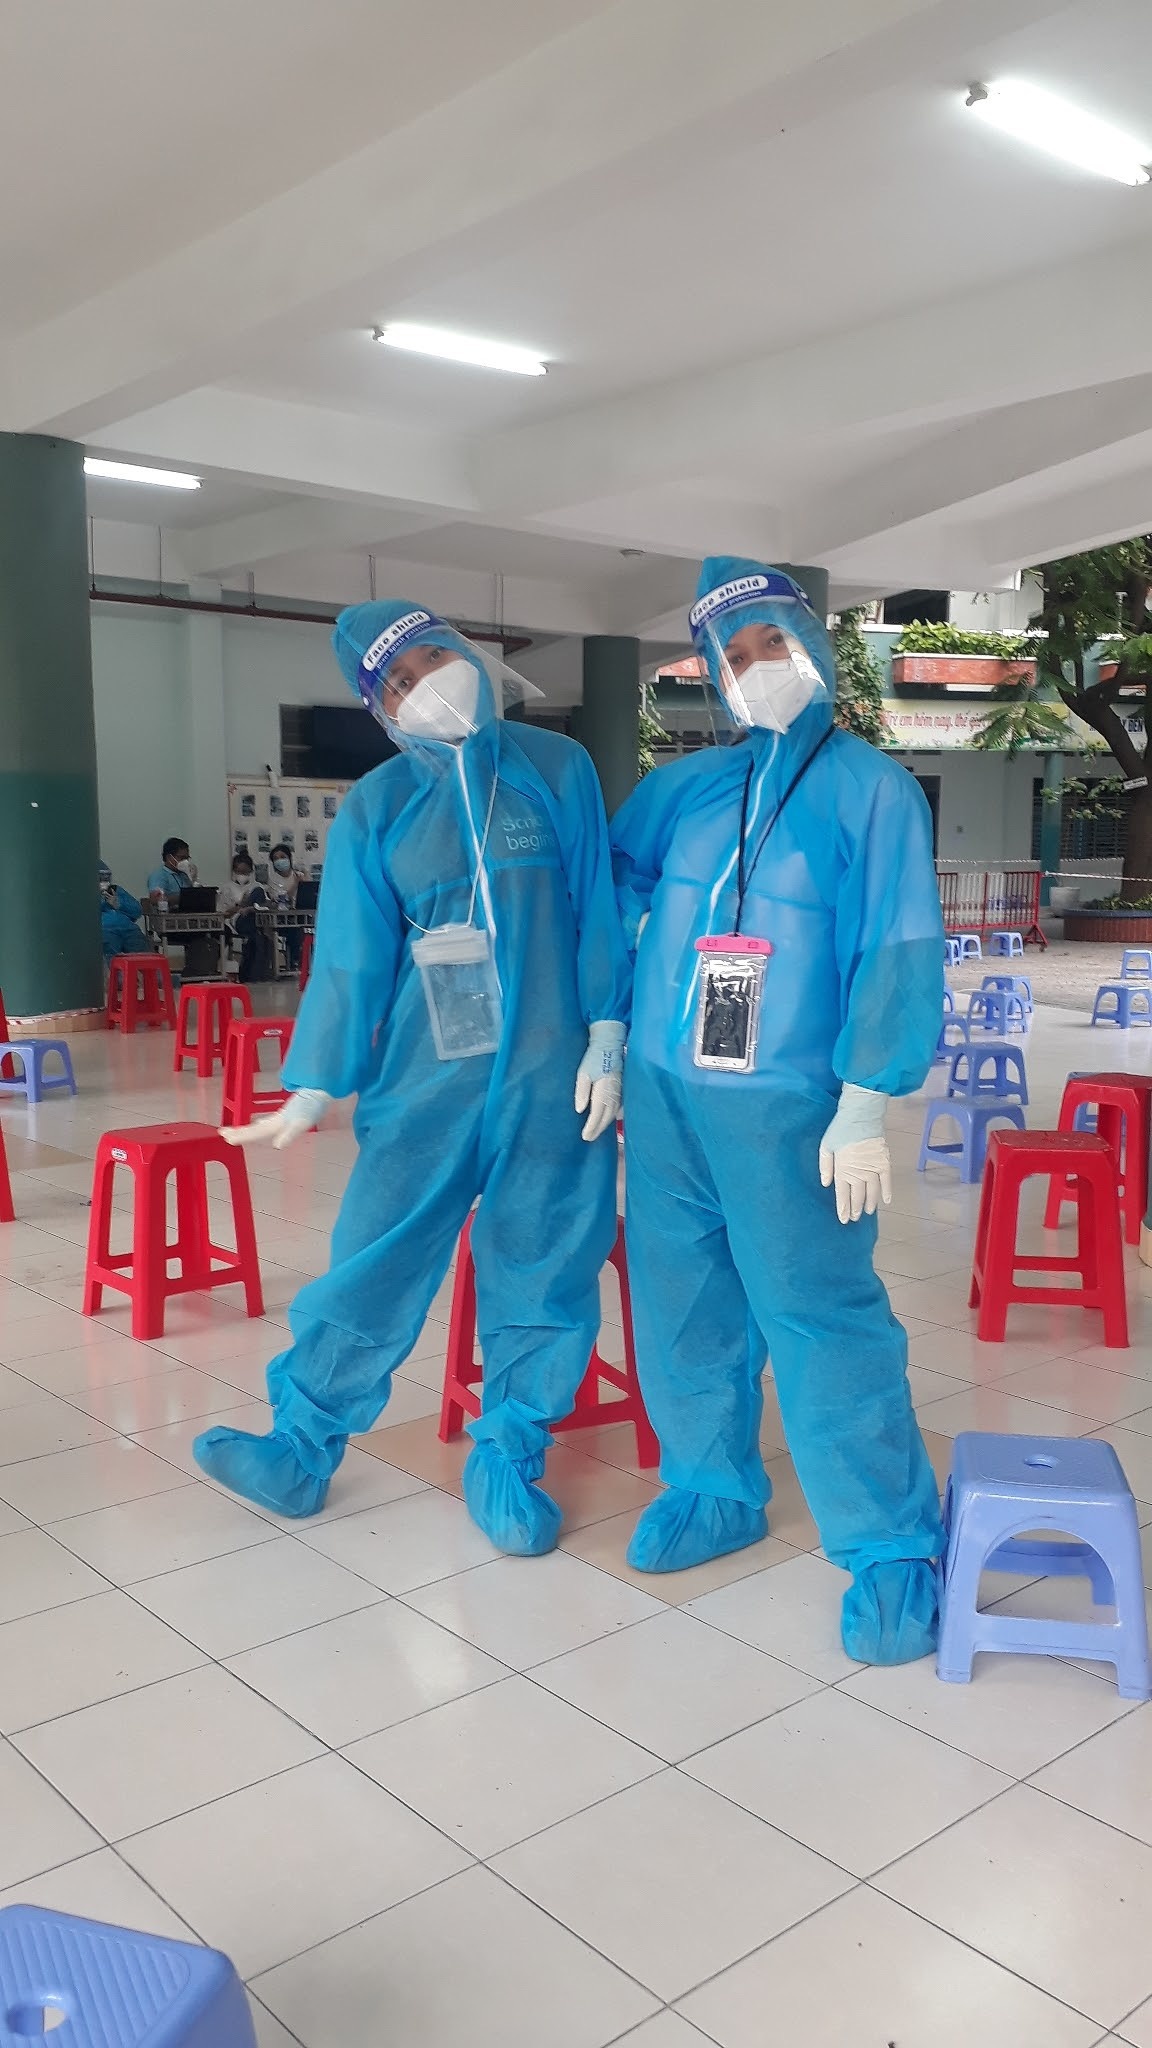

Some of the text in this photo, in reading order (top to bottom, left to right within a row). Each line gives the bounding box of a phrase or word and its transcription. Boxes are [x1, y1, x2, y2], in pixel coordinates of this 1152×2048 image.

[718, 578, 760, 599] shield
[367, 614, 424, 664] Face shield
